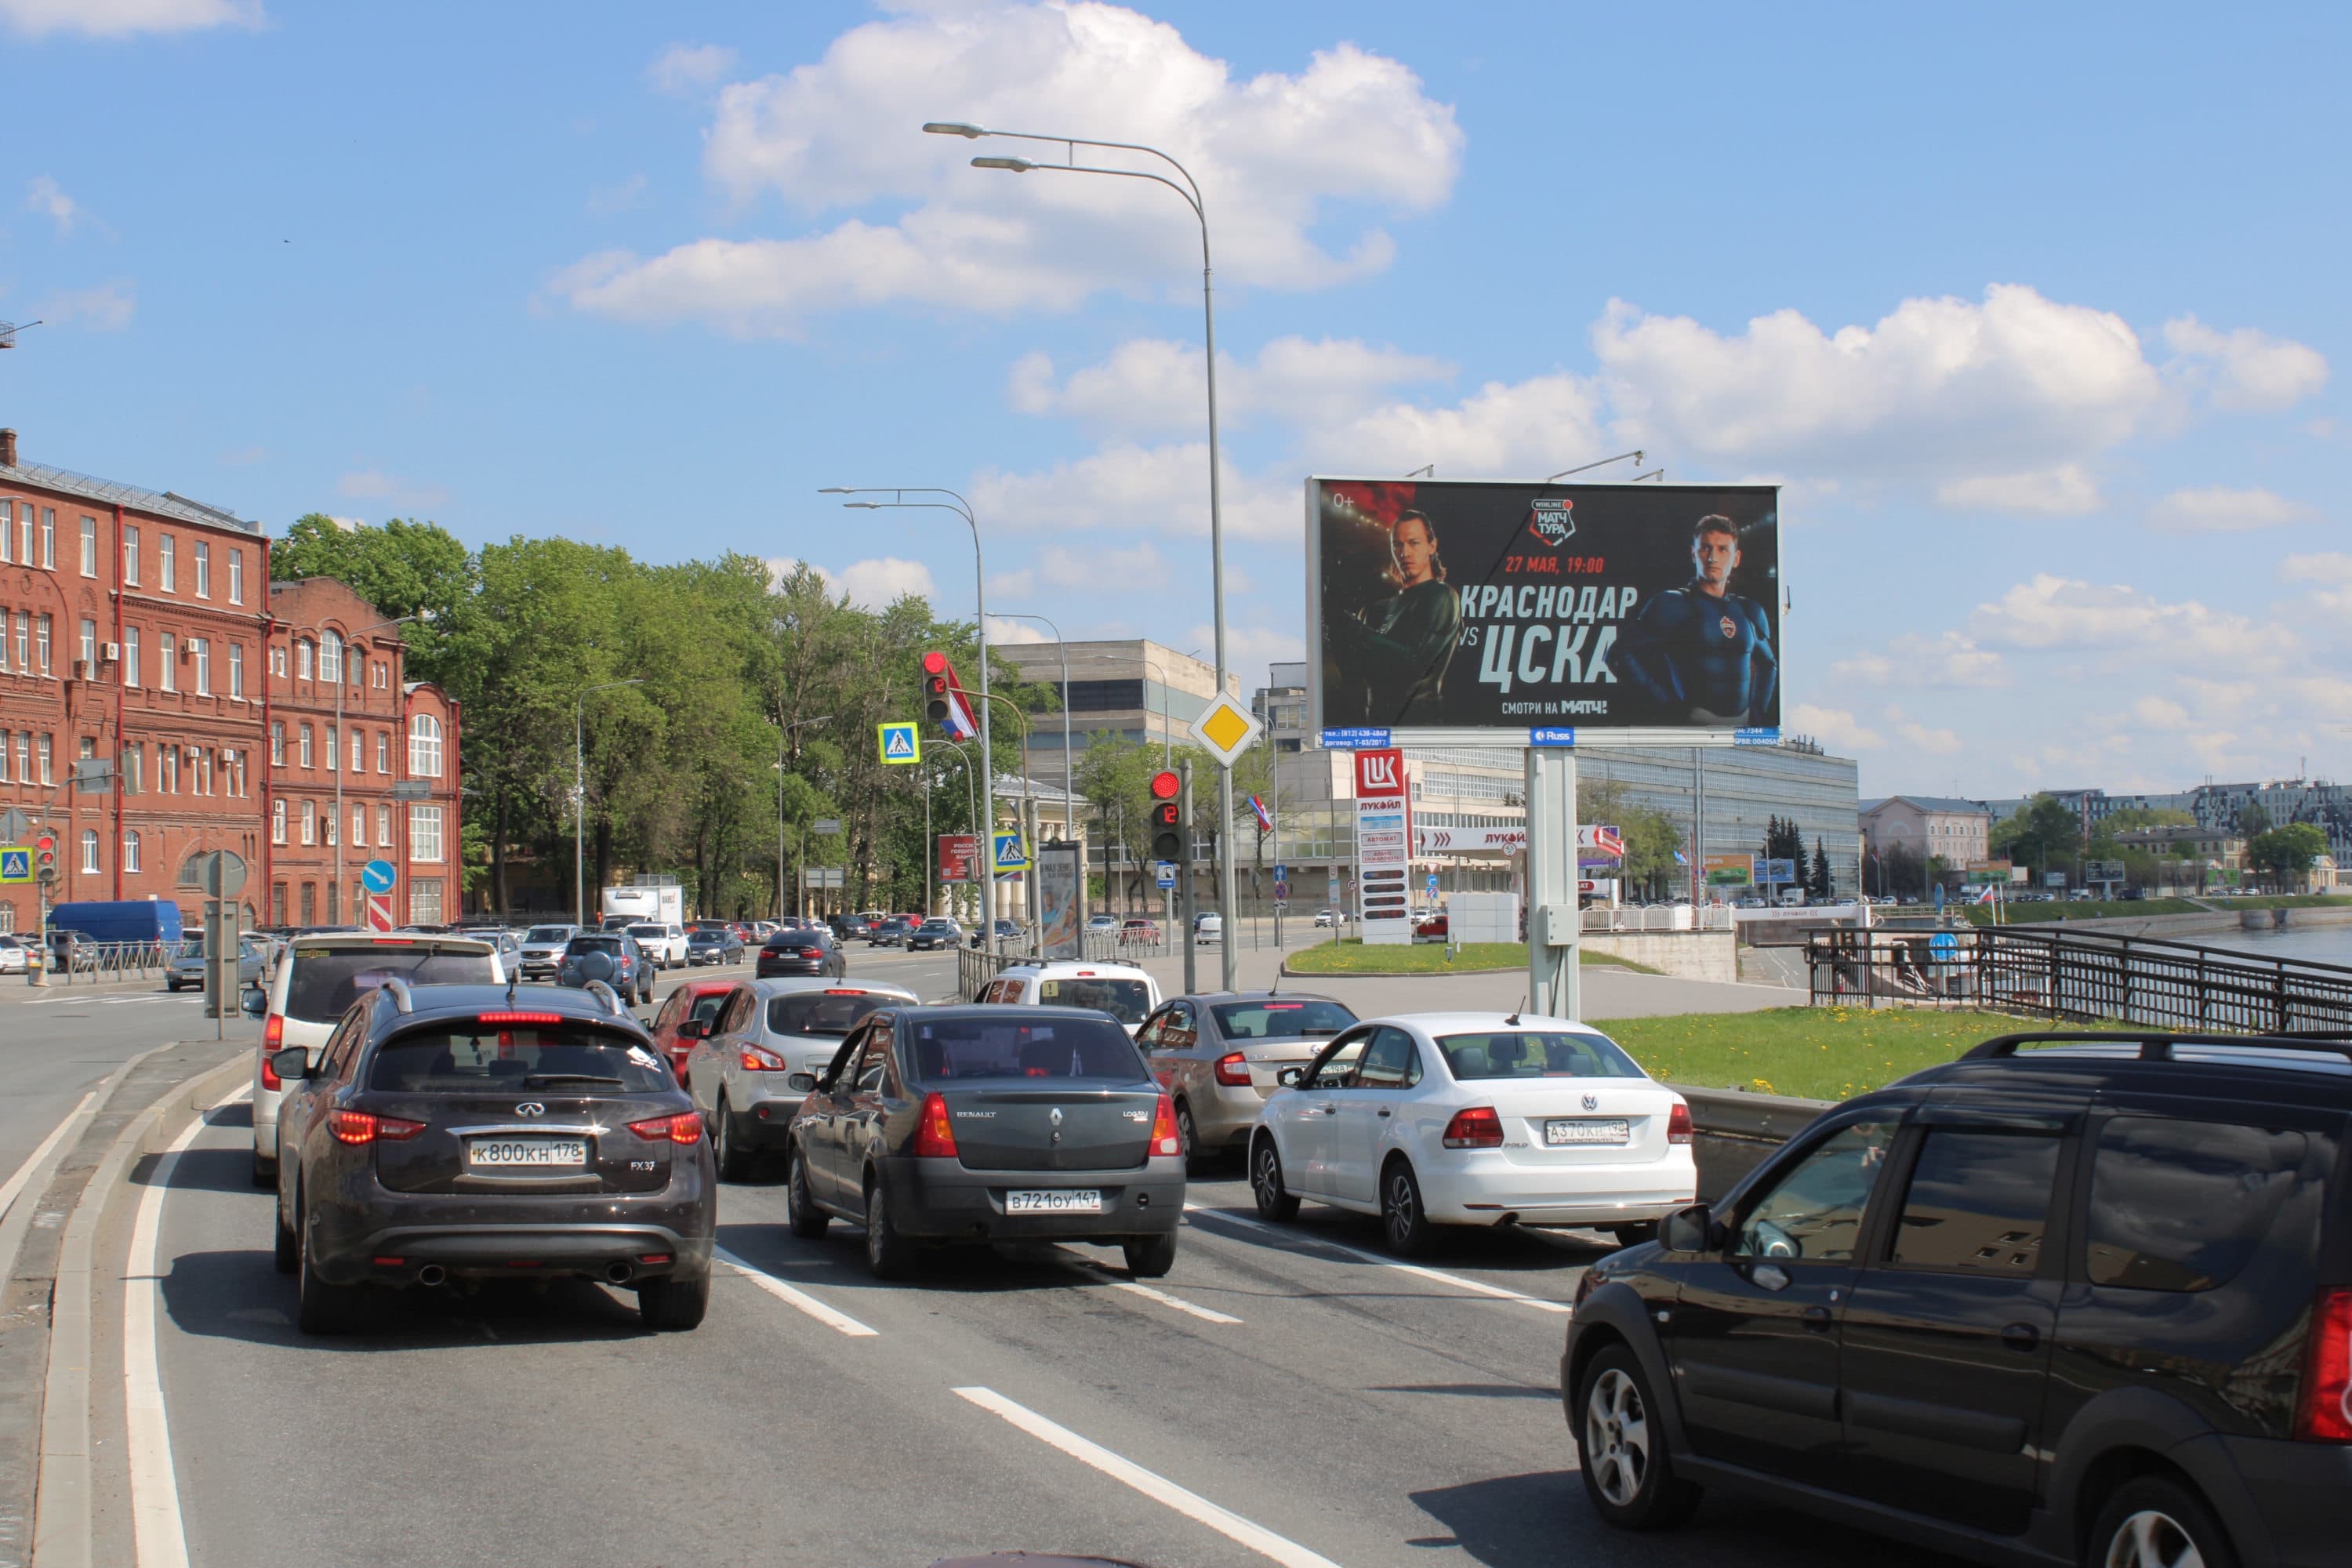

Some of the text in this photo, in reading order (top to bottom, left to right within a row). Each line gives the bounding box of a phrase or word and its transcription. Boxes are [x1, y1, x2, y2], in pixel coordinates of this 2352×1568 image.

[1334, 493, 1355, 507] 0+
[1537, 511, 1567, 524] МАТЧ
[1537, 523, 1566, 534] ТУРА
[1505, 557, 1604, 575] 27 МАЯ, 19:00
[1461, 585, 1638, 624] КРАСНОДАР
[1479, 624, 1617, 694] ЦСКА
[1501, 702, 1541, 714] СМОТРИ
[1545, 702, 1558, 714] НА
[1546, 731, 1570, 740] Russ
[1485, 832, 1526, 844] ЛУКОЙ
[554, 1143, 579, 1156] 178
[1075, 1192, 1097, 1204] 147
